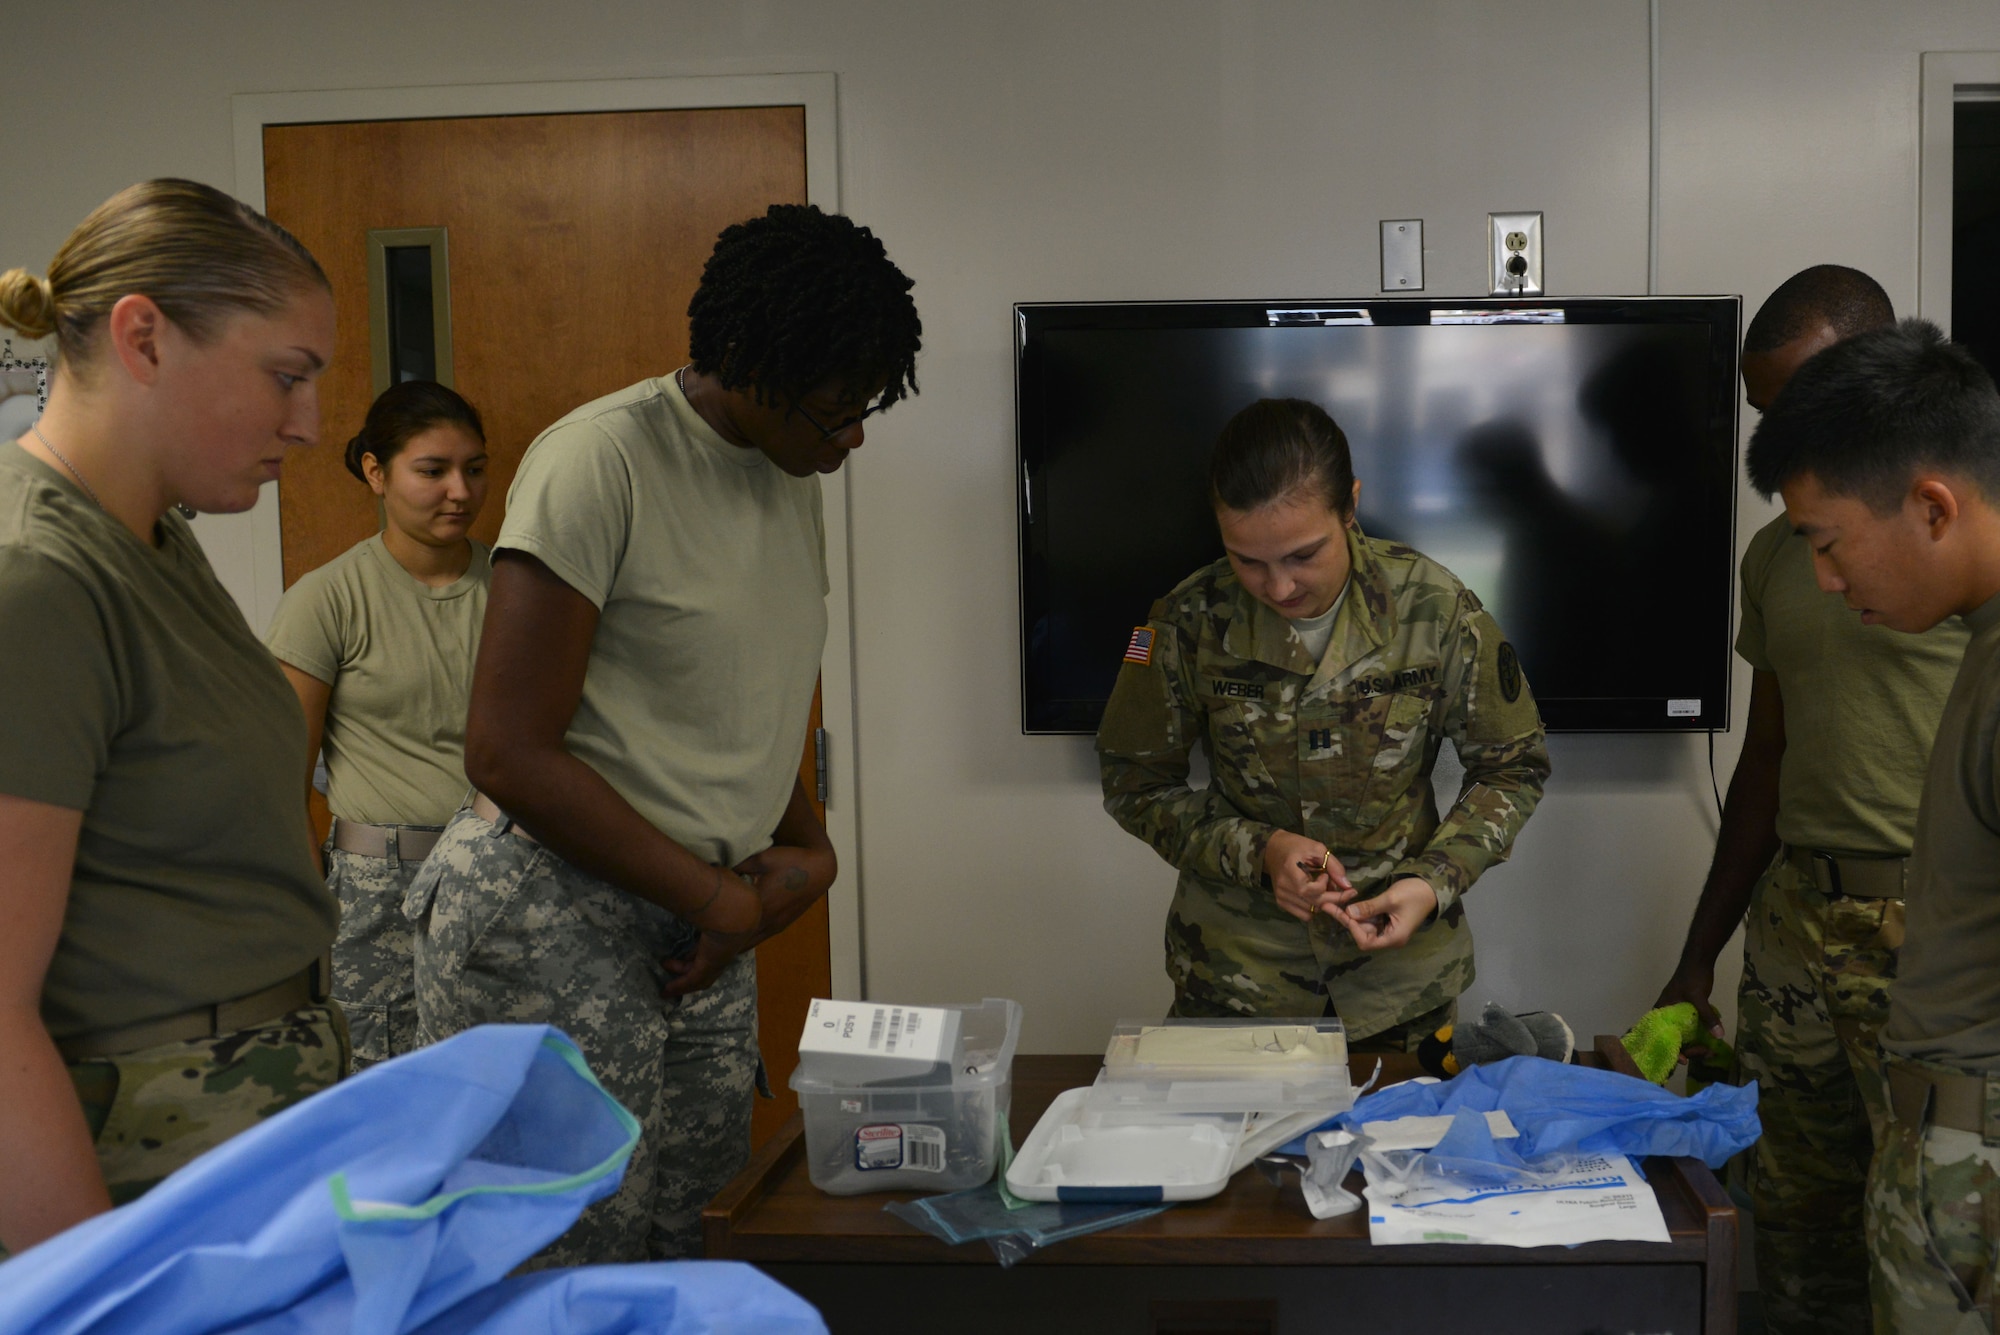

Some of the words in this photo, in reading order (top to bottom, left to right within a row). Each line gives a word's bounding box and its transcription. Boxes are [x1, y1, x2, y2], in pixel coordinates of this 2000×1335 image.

[1393, 666, 1437, 690] ARMY
[1212, 680, 1264, 700] WEBER
[863, 1127, 895, 1137] Sterilite
